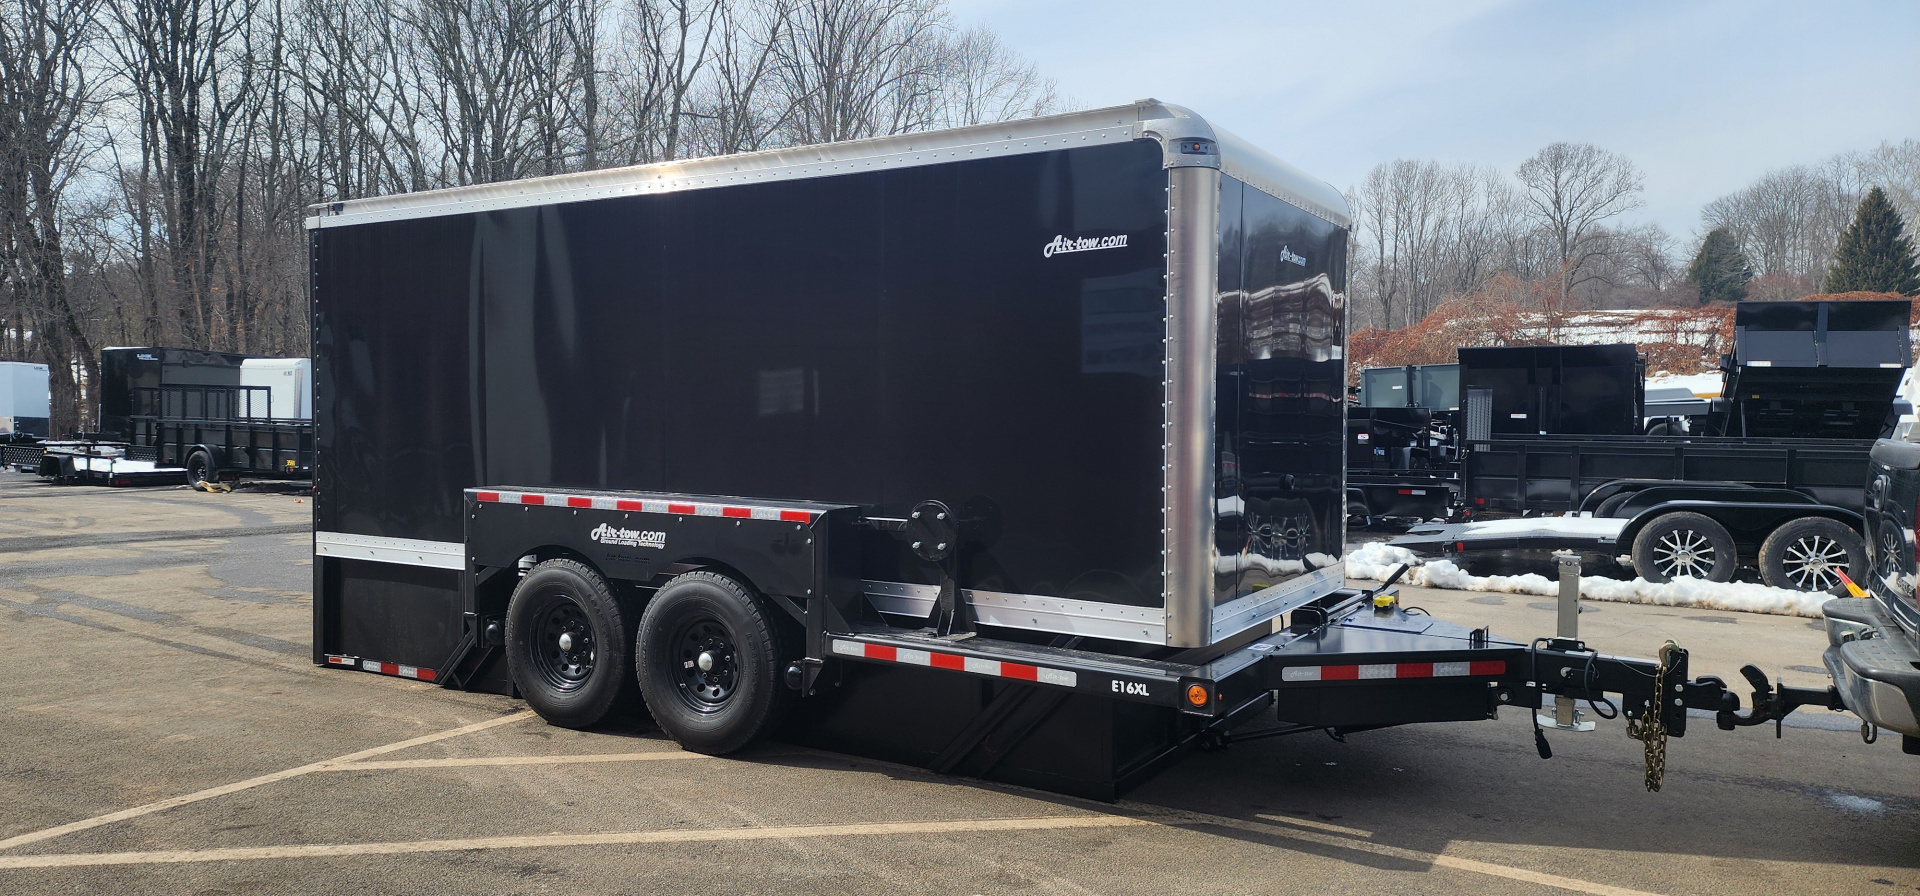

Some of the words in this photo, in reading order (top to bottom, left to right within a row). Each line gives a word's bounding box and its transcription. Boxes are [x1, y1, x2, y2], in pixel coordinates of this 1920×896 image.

[1043, 234, 1128, 258] Air-tow.com
[590, 522, 667, 542] Air-tow.com
[618, 540, 637, 548] Loading
[638, 541, 666, 550] Technology
[1111, 679, 1150, 697] E16XL
